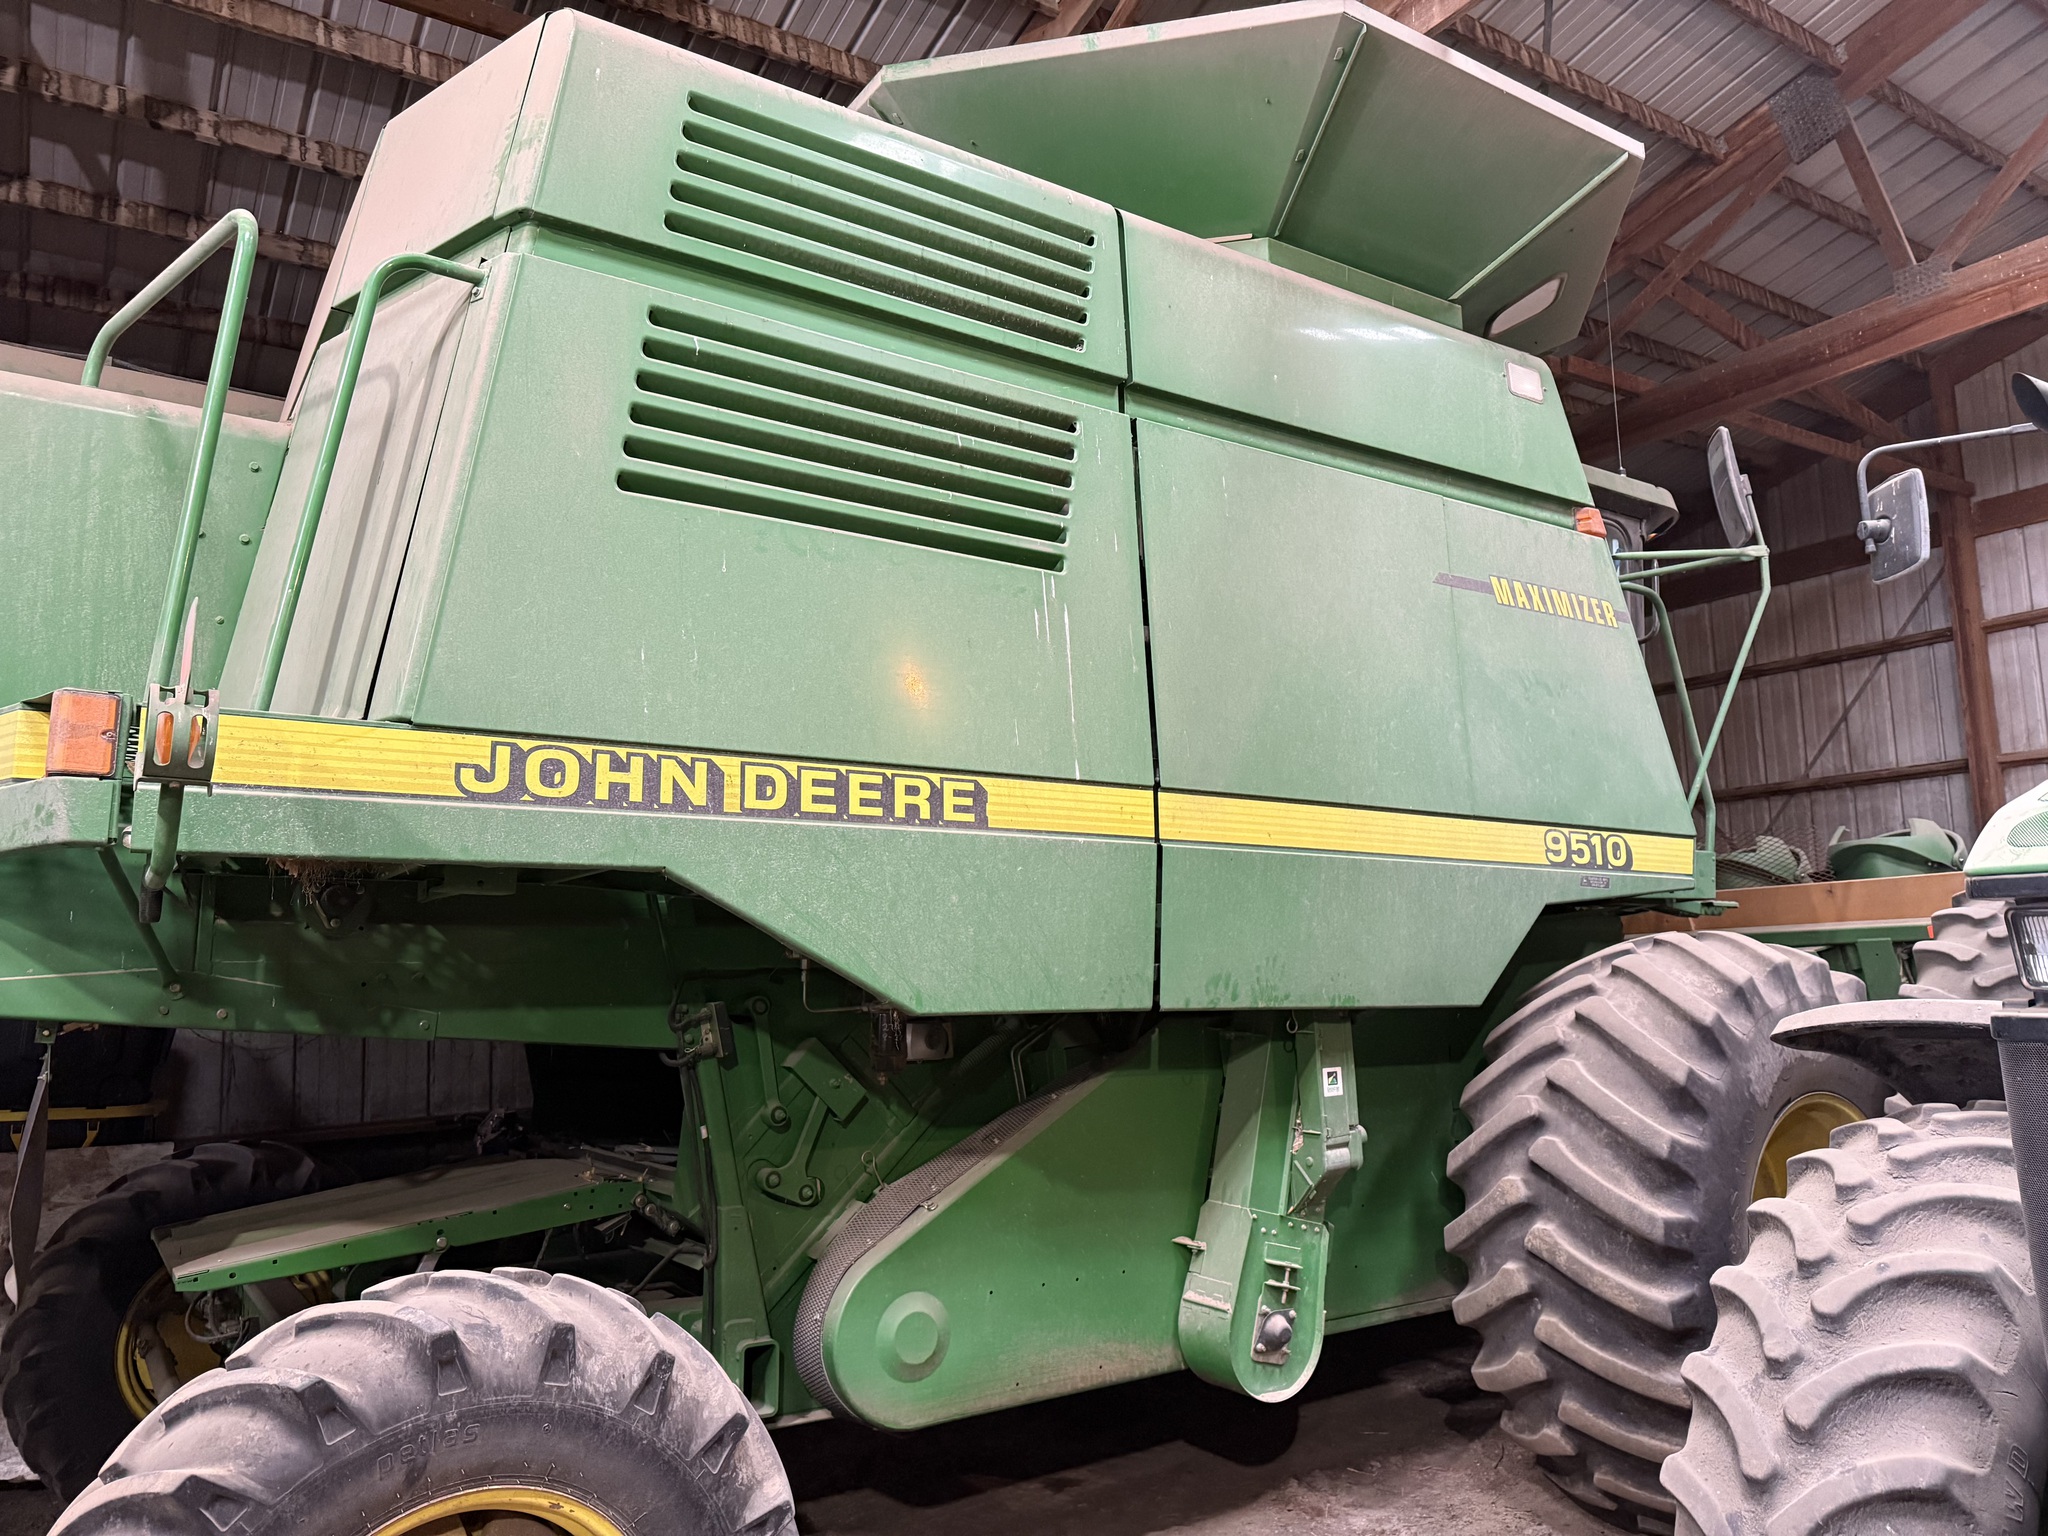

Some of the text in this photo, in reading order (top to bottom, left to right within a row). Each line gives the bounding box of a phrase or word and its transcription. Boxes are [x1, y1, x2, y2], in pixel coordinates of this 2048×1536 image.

[1489, 575, 1619, 628] MAXIMIZER
[455, 742, 986, 828] JOHN DEERE
[1544, 829, 1632, 870] 9510
